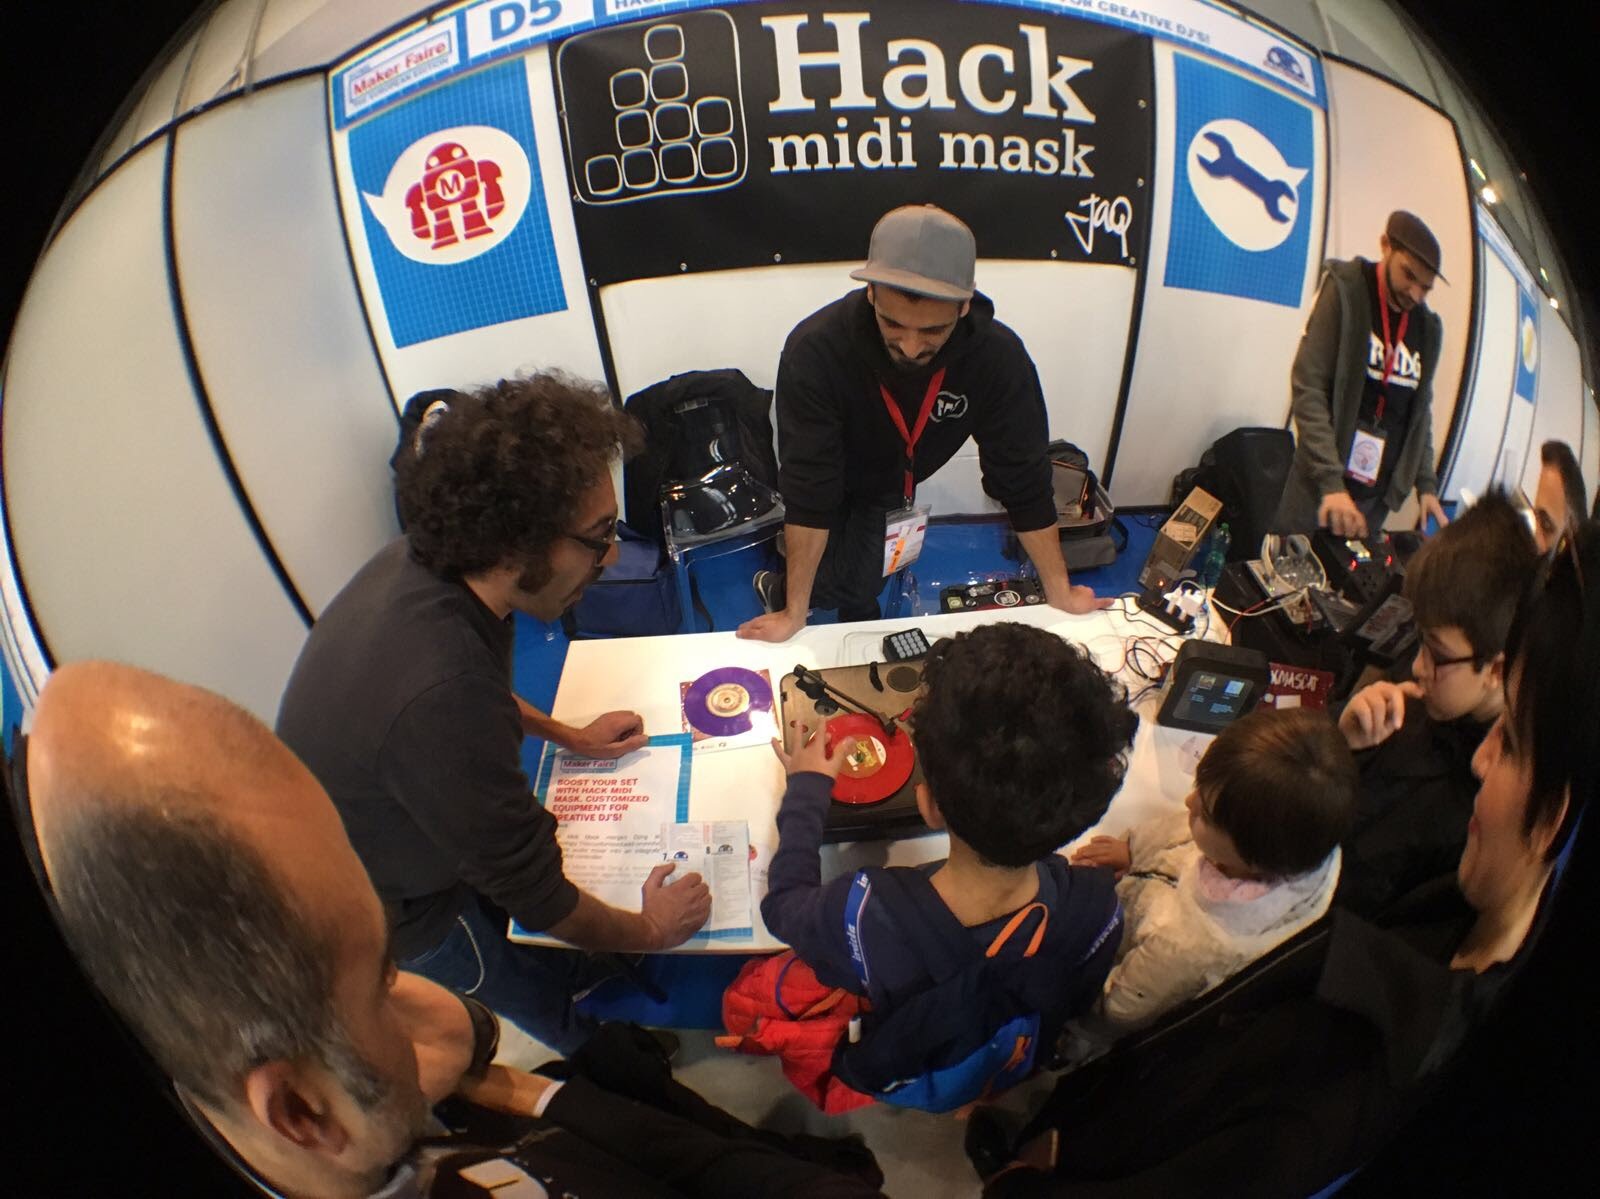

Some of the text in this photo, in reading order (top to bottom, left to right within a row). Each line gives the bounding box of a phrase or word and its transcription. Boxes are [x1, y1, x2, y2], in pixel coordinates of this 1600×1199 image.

[489, 0, 562, 42] D5
[1097, 1, 1173, 31] CREATIVE
[353, 65, 400, 96] Maker
[404, 43, 446, 68] Faire
[760, 12, 1096, 125] Hack
[767, 116, 1096, 179] midi mask
[563, 759, 615, 768] Maker Faire
[620, 778, 638, 786] SET
[552, 804, 606, 812] EQUIPMENT
[585, 795, 650, 803] CUSTOMIZED
[557, 814, 596, 822] REATIVE
